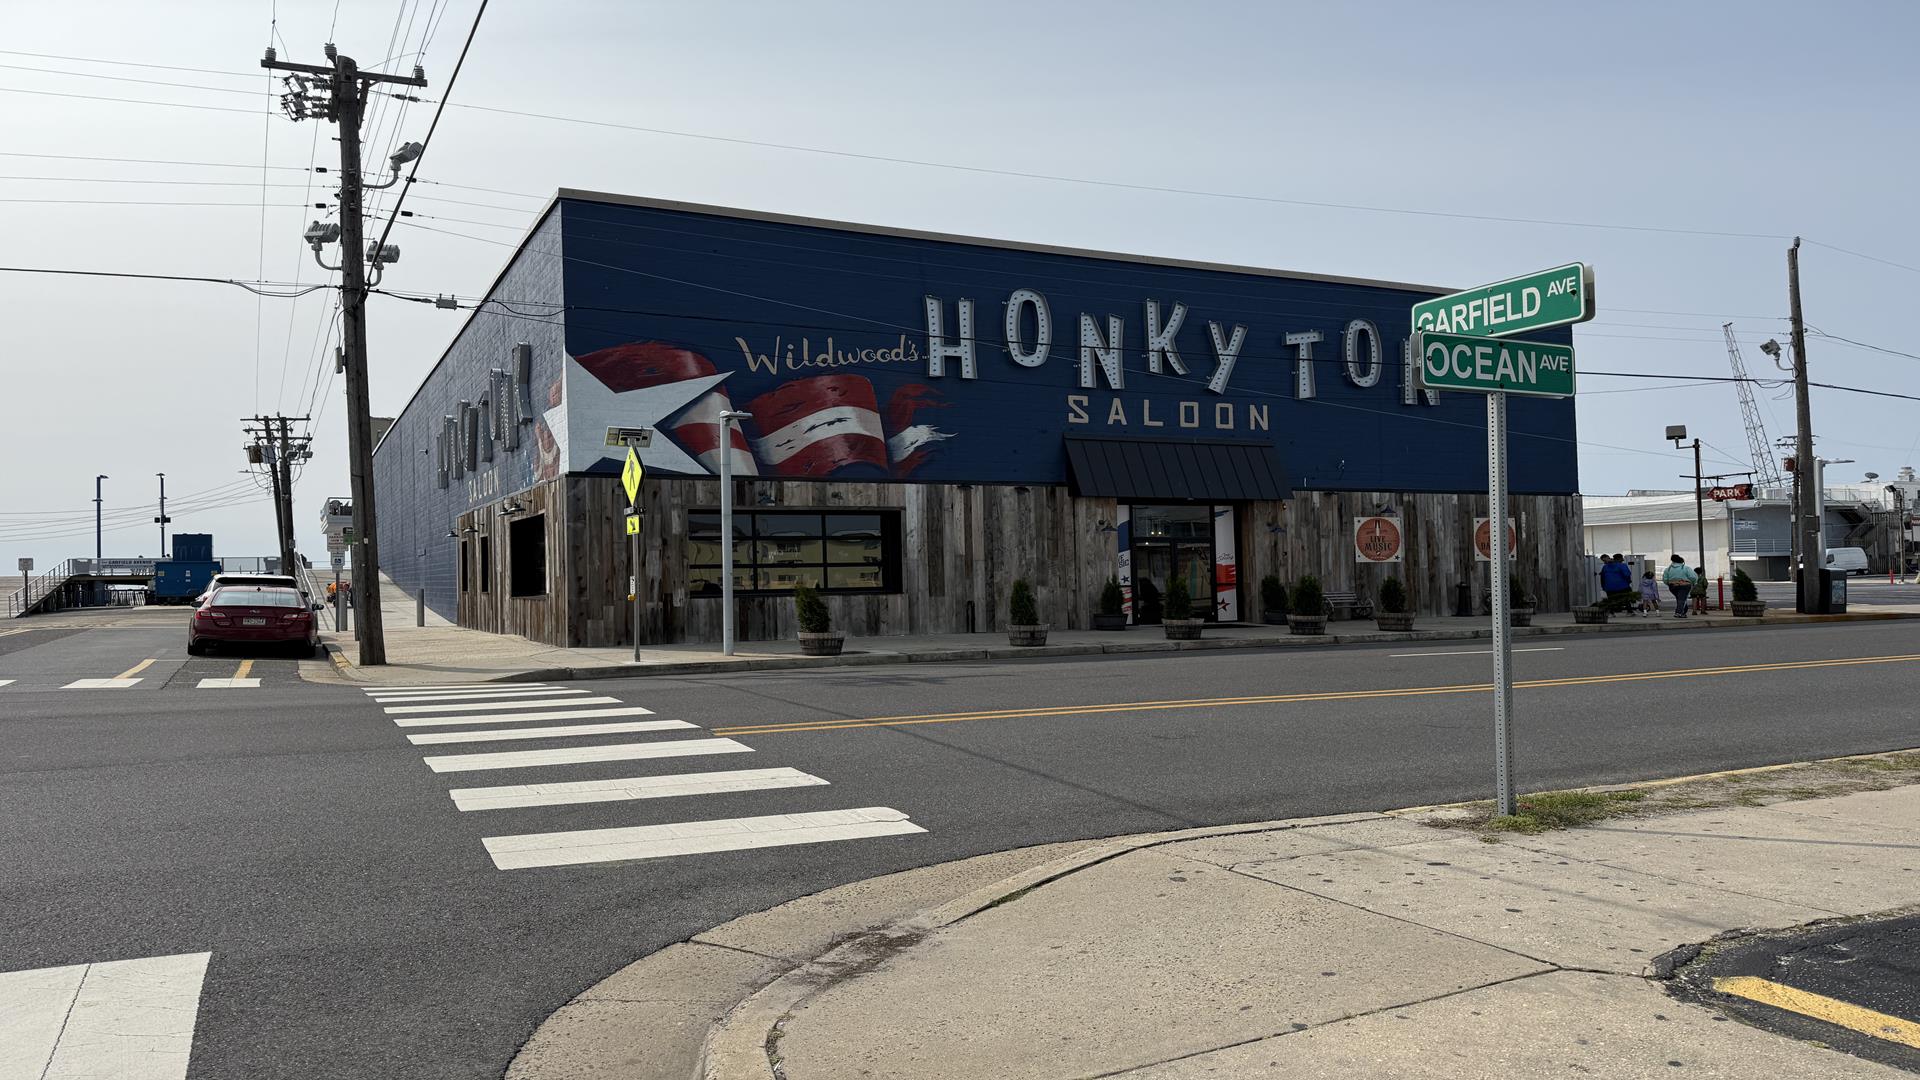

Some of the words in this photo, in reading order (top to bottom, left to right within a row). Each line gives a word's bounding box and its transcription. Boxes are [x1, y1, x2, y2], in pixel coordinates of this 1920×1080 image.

[1418, 287, 1541, 333] GARFIELD
[1547, 276, 1576, 297] AVE
[735, 335, 919, 375] Wildwood's
[925, 288, 1248, 395] HONKY
[1427, 342, 1537, 384] OCEAN
[1540, 354, 1568, 371] AVE
[1067, 395, 1269, 431] SALOON
[468, 466, 499, 503] SALOON
[1713, 489, 1742, 498] PARK
[1364, 543, 1393, 551] MUSIC
